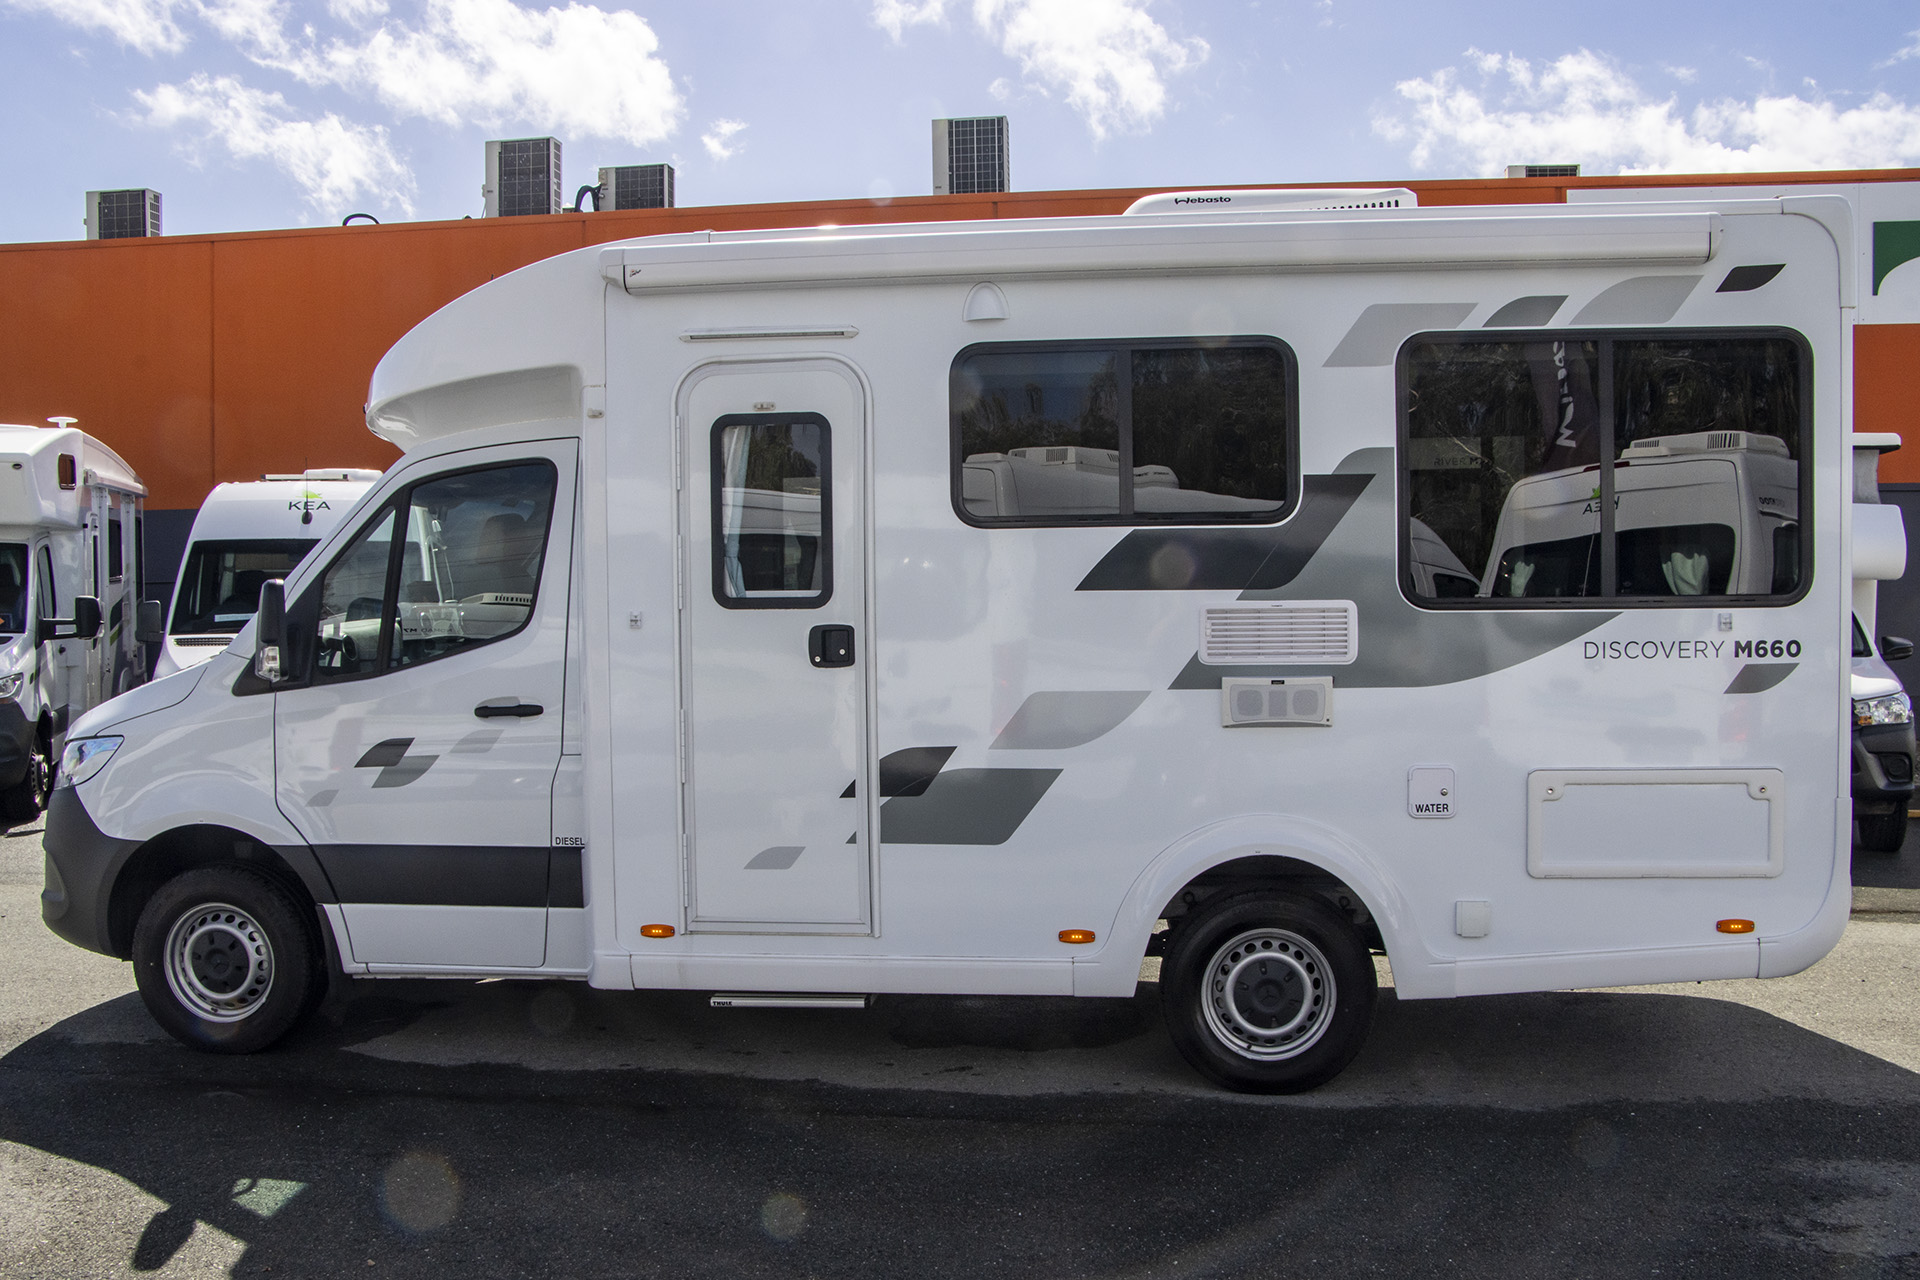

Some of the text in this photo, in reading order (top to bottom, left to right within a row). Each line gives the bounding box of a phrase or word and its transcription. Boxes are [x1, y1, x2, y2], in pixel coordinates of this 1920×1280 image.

[1174, 196, 1232, 205] Webasto
[288, 501, 331, 511] KEA
[1584, 639, 1802, 660] DISCOVERY M660
[1415, 803, 1449, 813] WATER
[555, 836, 585, 846] DIESEL
